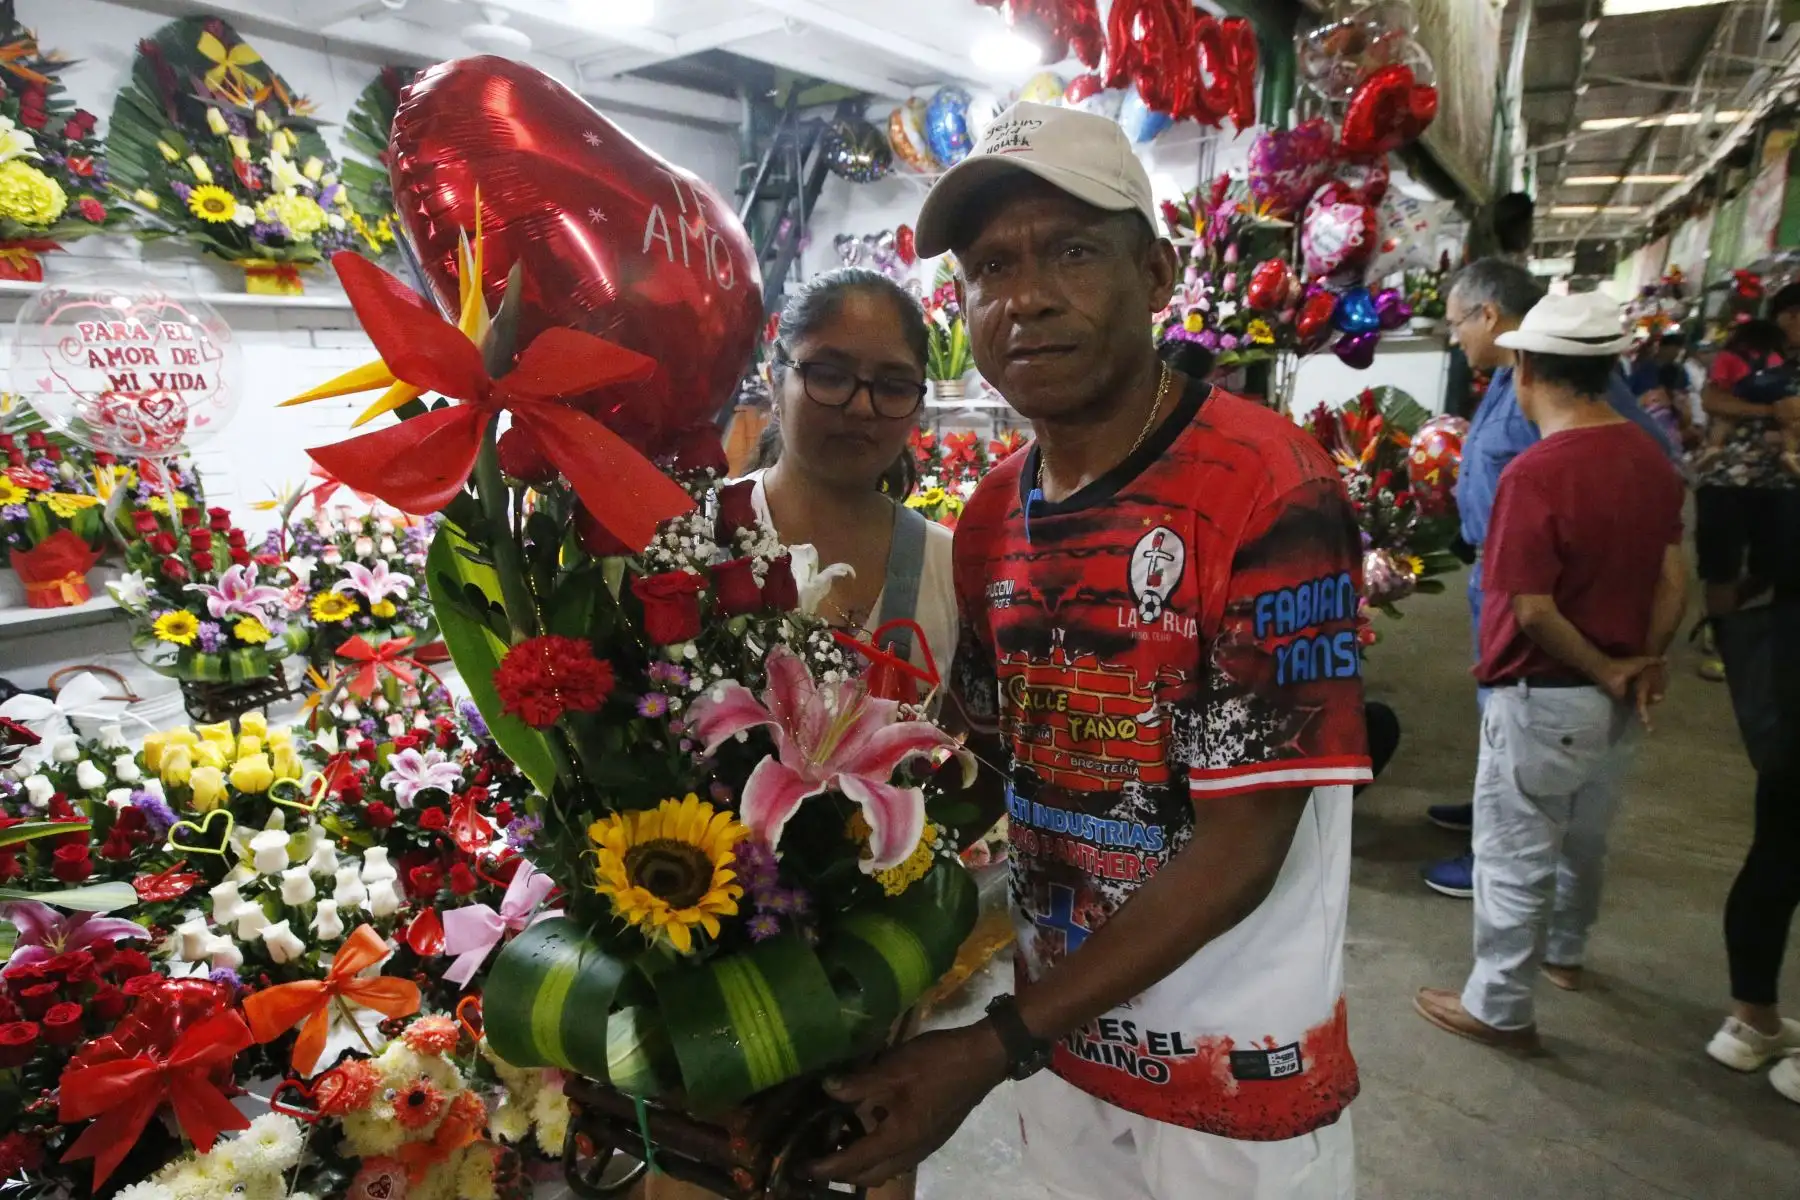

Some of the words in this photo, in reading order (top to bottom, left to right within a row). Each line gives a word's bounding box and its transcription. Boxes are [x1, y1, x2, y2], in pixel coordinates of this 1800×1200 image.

[654, 165, 717, 233] TE
[642, 204, 734, 290] AMO
[77, 321, 150, 342] PARA
[160, 322, 193, 341] EL
[88, 346, 160, 368] AMOR
[171, 347, 200, 365] DE
[108, 373, 142, 392] MI
[150, 372, 208, 391] VIDA
[1118, 606, 1138, 629] LA
[1254, 572, 1356, 639] FABIAN
[1067, 715, 1138, 743] TANO
[1032, 801, 1164, 852] INDUSTRIAS
[1098, 1017, 1140, 1048] ES
[1146, 1030, 1197, 1057] EL
